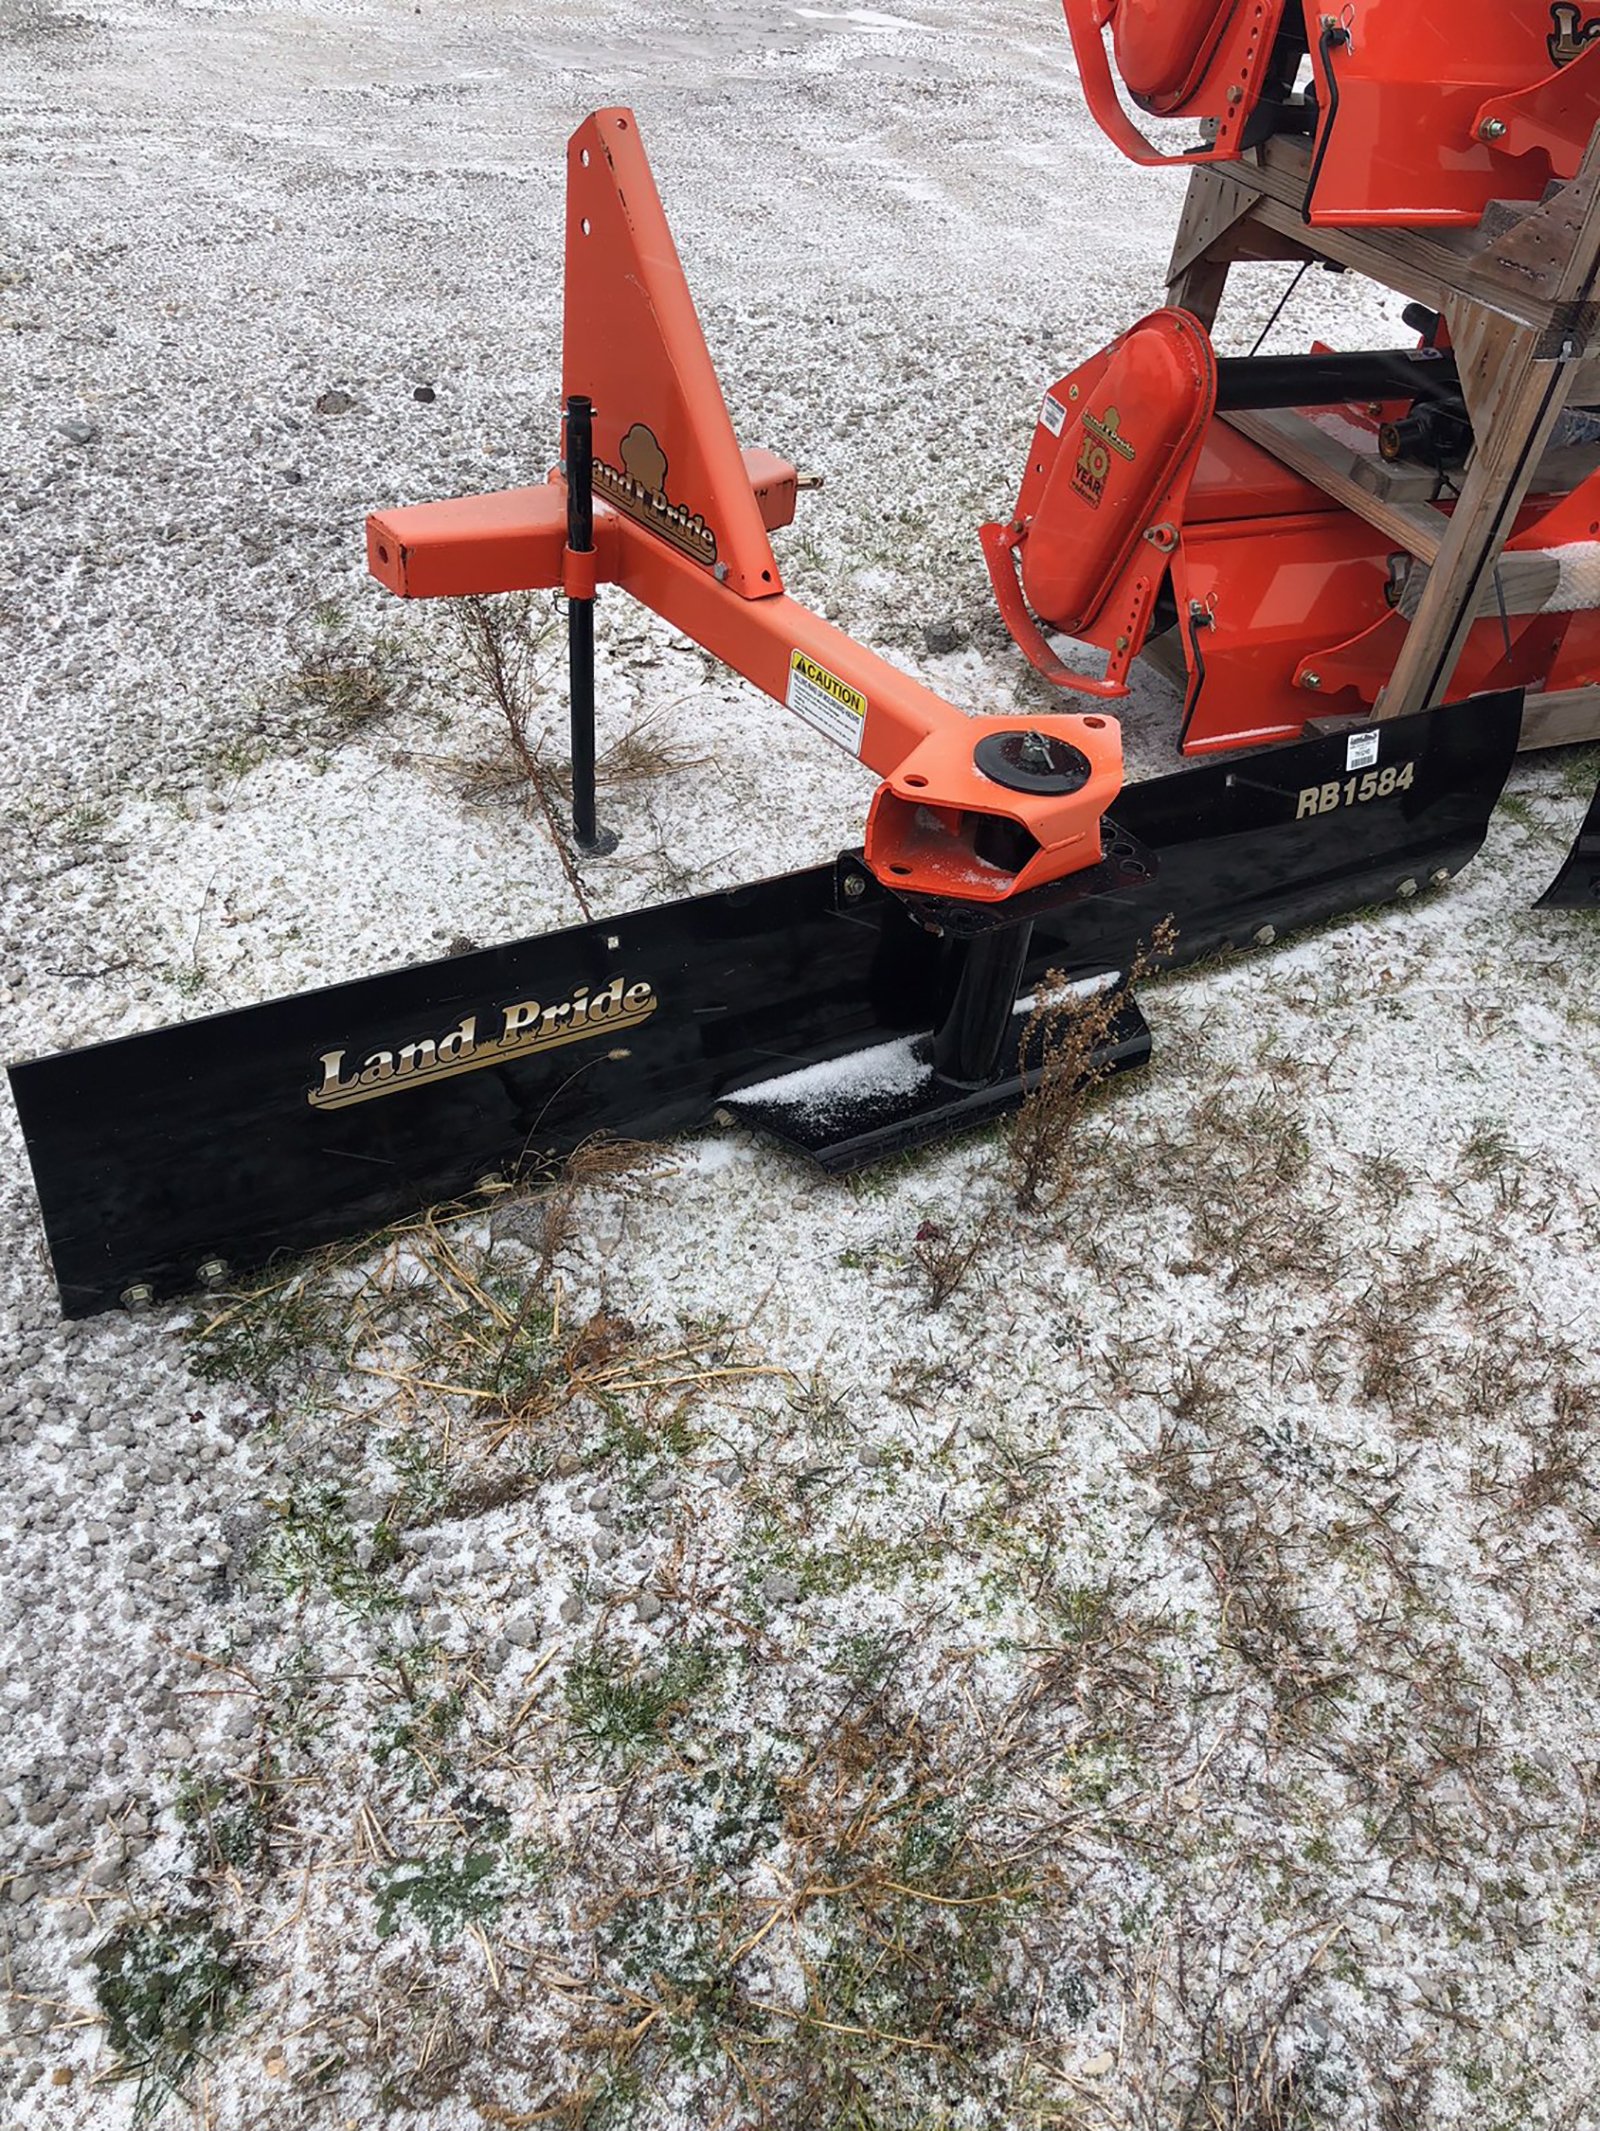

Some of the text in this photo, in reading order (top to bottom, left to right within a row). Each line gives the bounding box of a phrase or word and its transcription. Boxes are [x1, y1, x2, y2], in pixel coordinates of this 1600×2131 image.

[1076, 463, 1102, 495] YEAR
[1078, 437, 1108, 478] 10
[592, 458, 715, 553] and Pride
[807, 664, 861, 711] CAUTION
[1295, 761, 1415, 820] RB1584
[316, 976, 652, 1097] Land Pride
